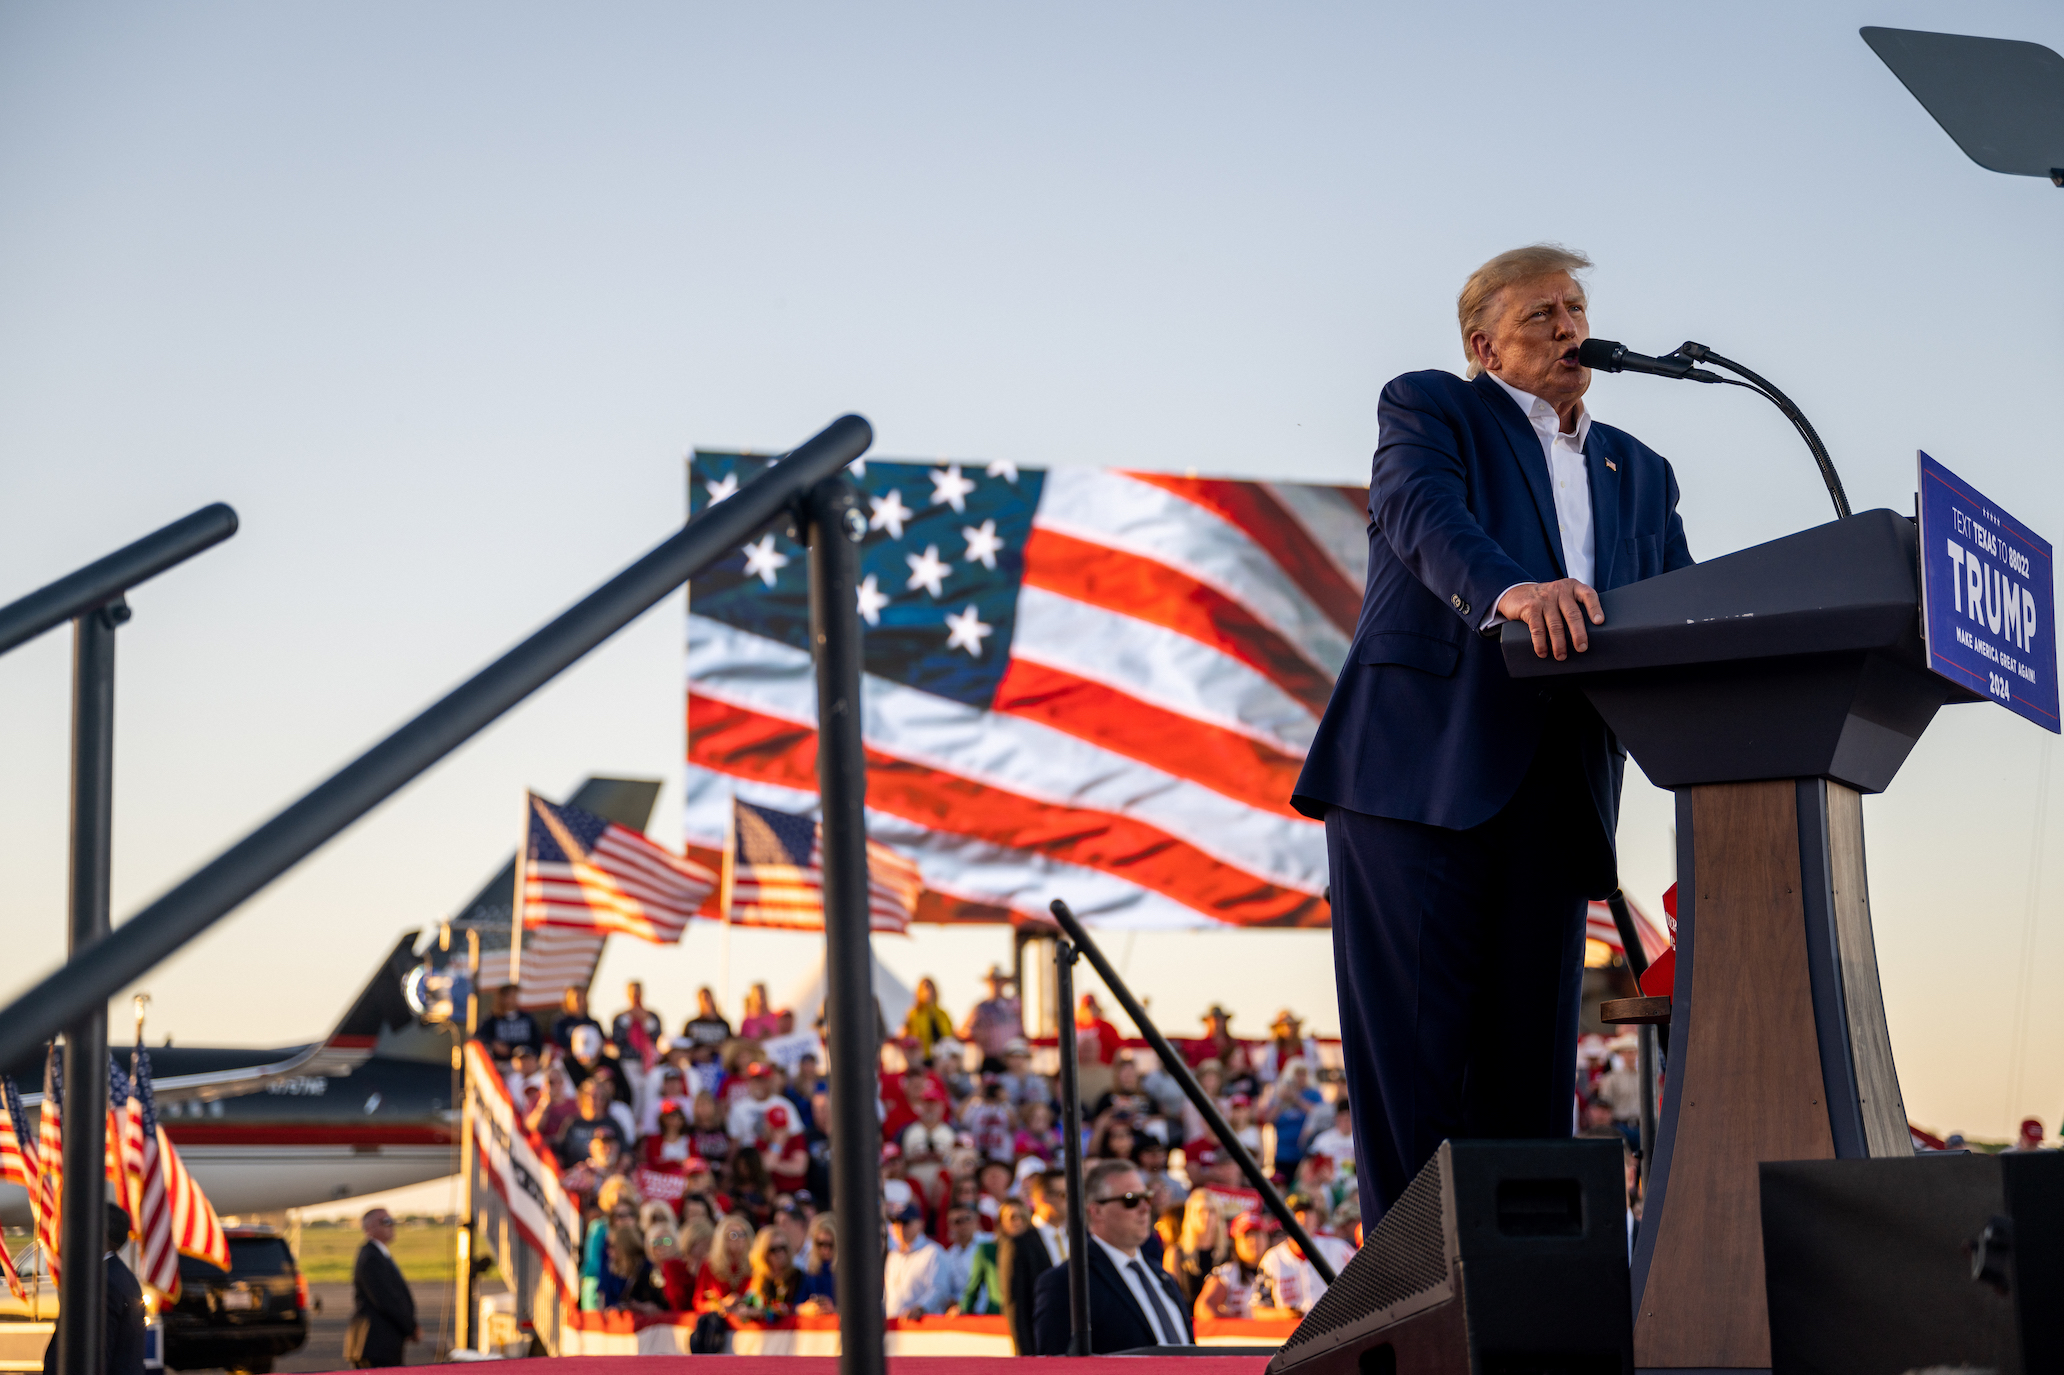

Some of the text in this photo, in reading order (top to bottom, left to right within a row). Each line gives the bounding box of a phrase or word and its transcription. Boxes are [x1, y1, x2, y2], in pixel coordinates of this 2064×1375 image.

[1951, 506, 2030, 579] TEXT TEXAS TO 88022
[1947, 538, 2037, 654] TRUMP
[1956, 626, 2037, 685] MAKE AMERICA GREAT AGAIN!
[1989, 671, 2010, 702] 2024
